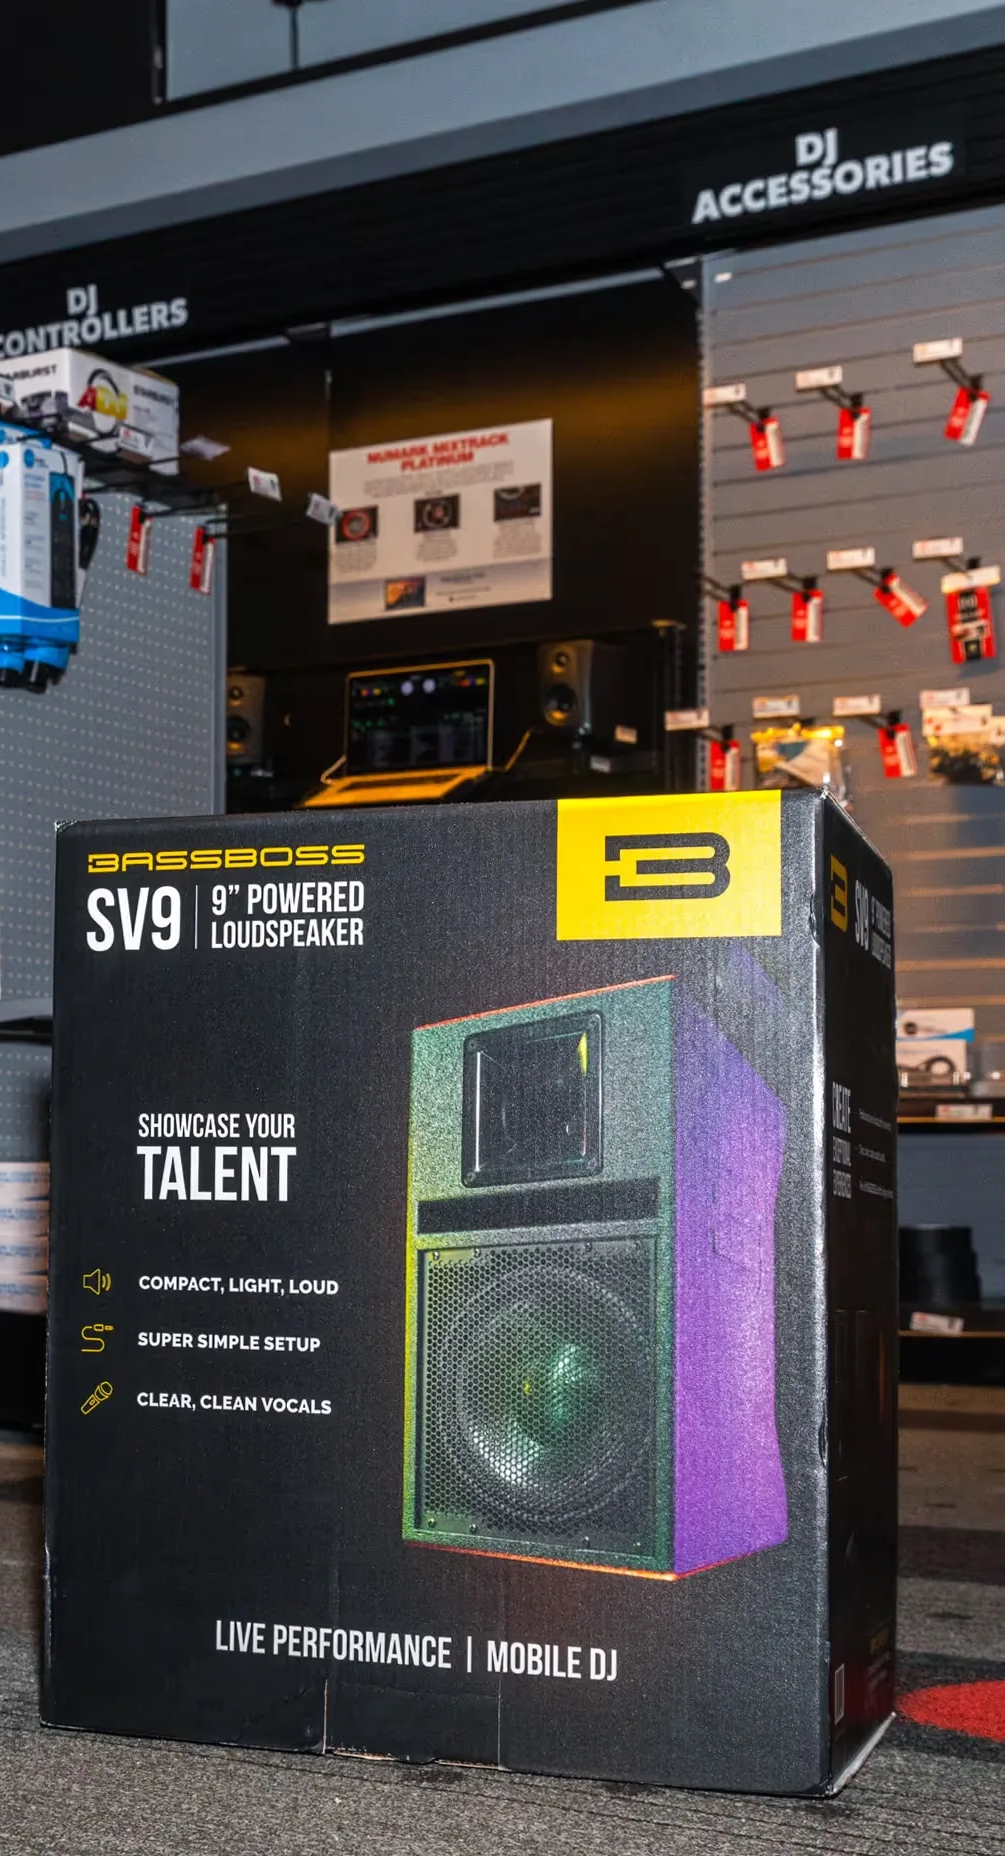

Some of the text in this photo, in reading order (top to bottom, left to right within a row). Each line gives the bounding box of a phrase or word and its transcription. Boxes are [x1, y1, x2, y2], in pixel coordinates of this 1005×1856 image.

[795, 127, 838, 167] DJ
[692, 141, 954, 224] ACCESSORIES
[66, 283, 99, 317] DJ
[401, 452, 474, 472] PLATINUM
[88, 844, 365, 873] BASSBOSS
[247, 880, 365, 915] POWERED
[86, 885, 181, 951] SV9
[211, 917, 364, 949] LOUDSPEAKER
[138, 1113, 295, 1139] SHOWCASE YOUR
[136, 1145, 297, 1202] TALENT
[138, 1275, 339, 1296] COMPACT, LIGHT, LOUD
[137, 1331, 321, 1352] SUPER SIMPLE SETUP
[136, 1391, 332, 1415] CLEAR, CLEAN VOCALS
[215, 1619, 266, 1654] LIVE
[272, 1624, 452, 1669] PERFORMANCE
[487, 1640, 582, 1679] MOBILE
[589, 1647, 618, 1682] DJ
